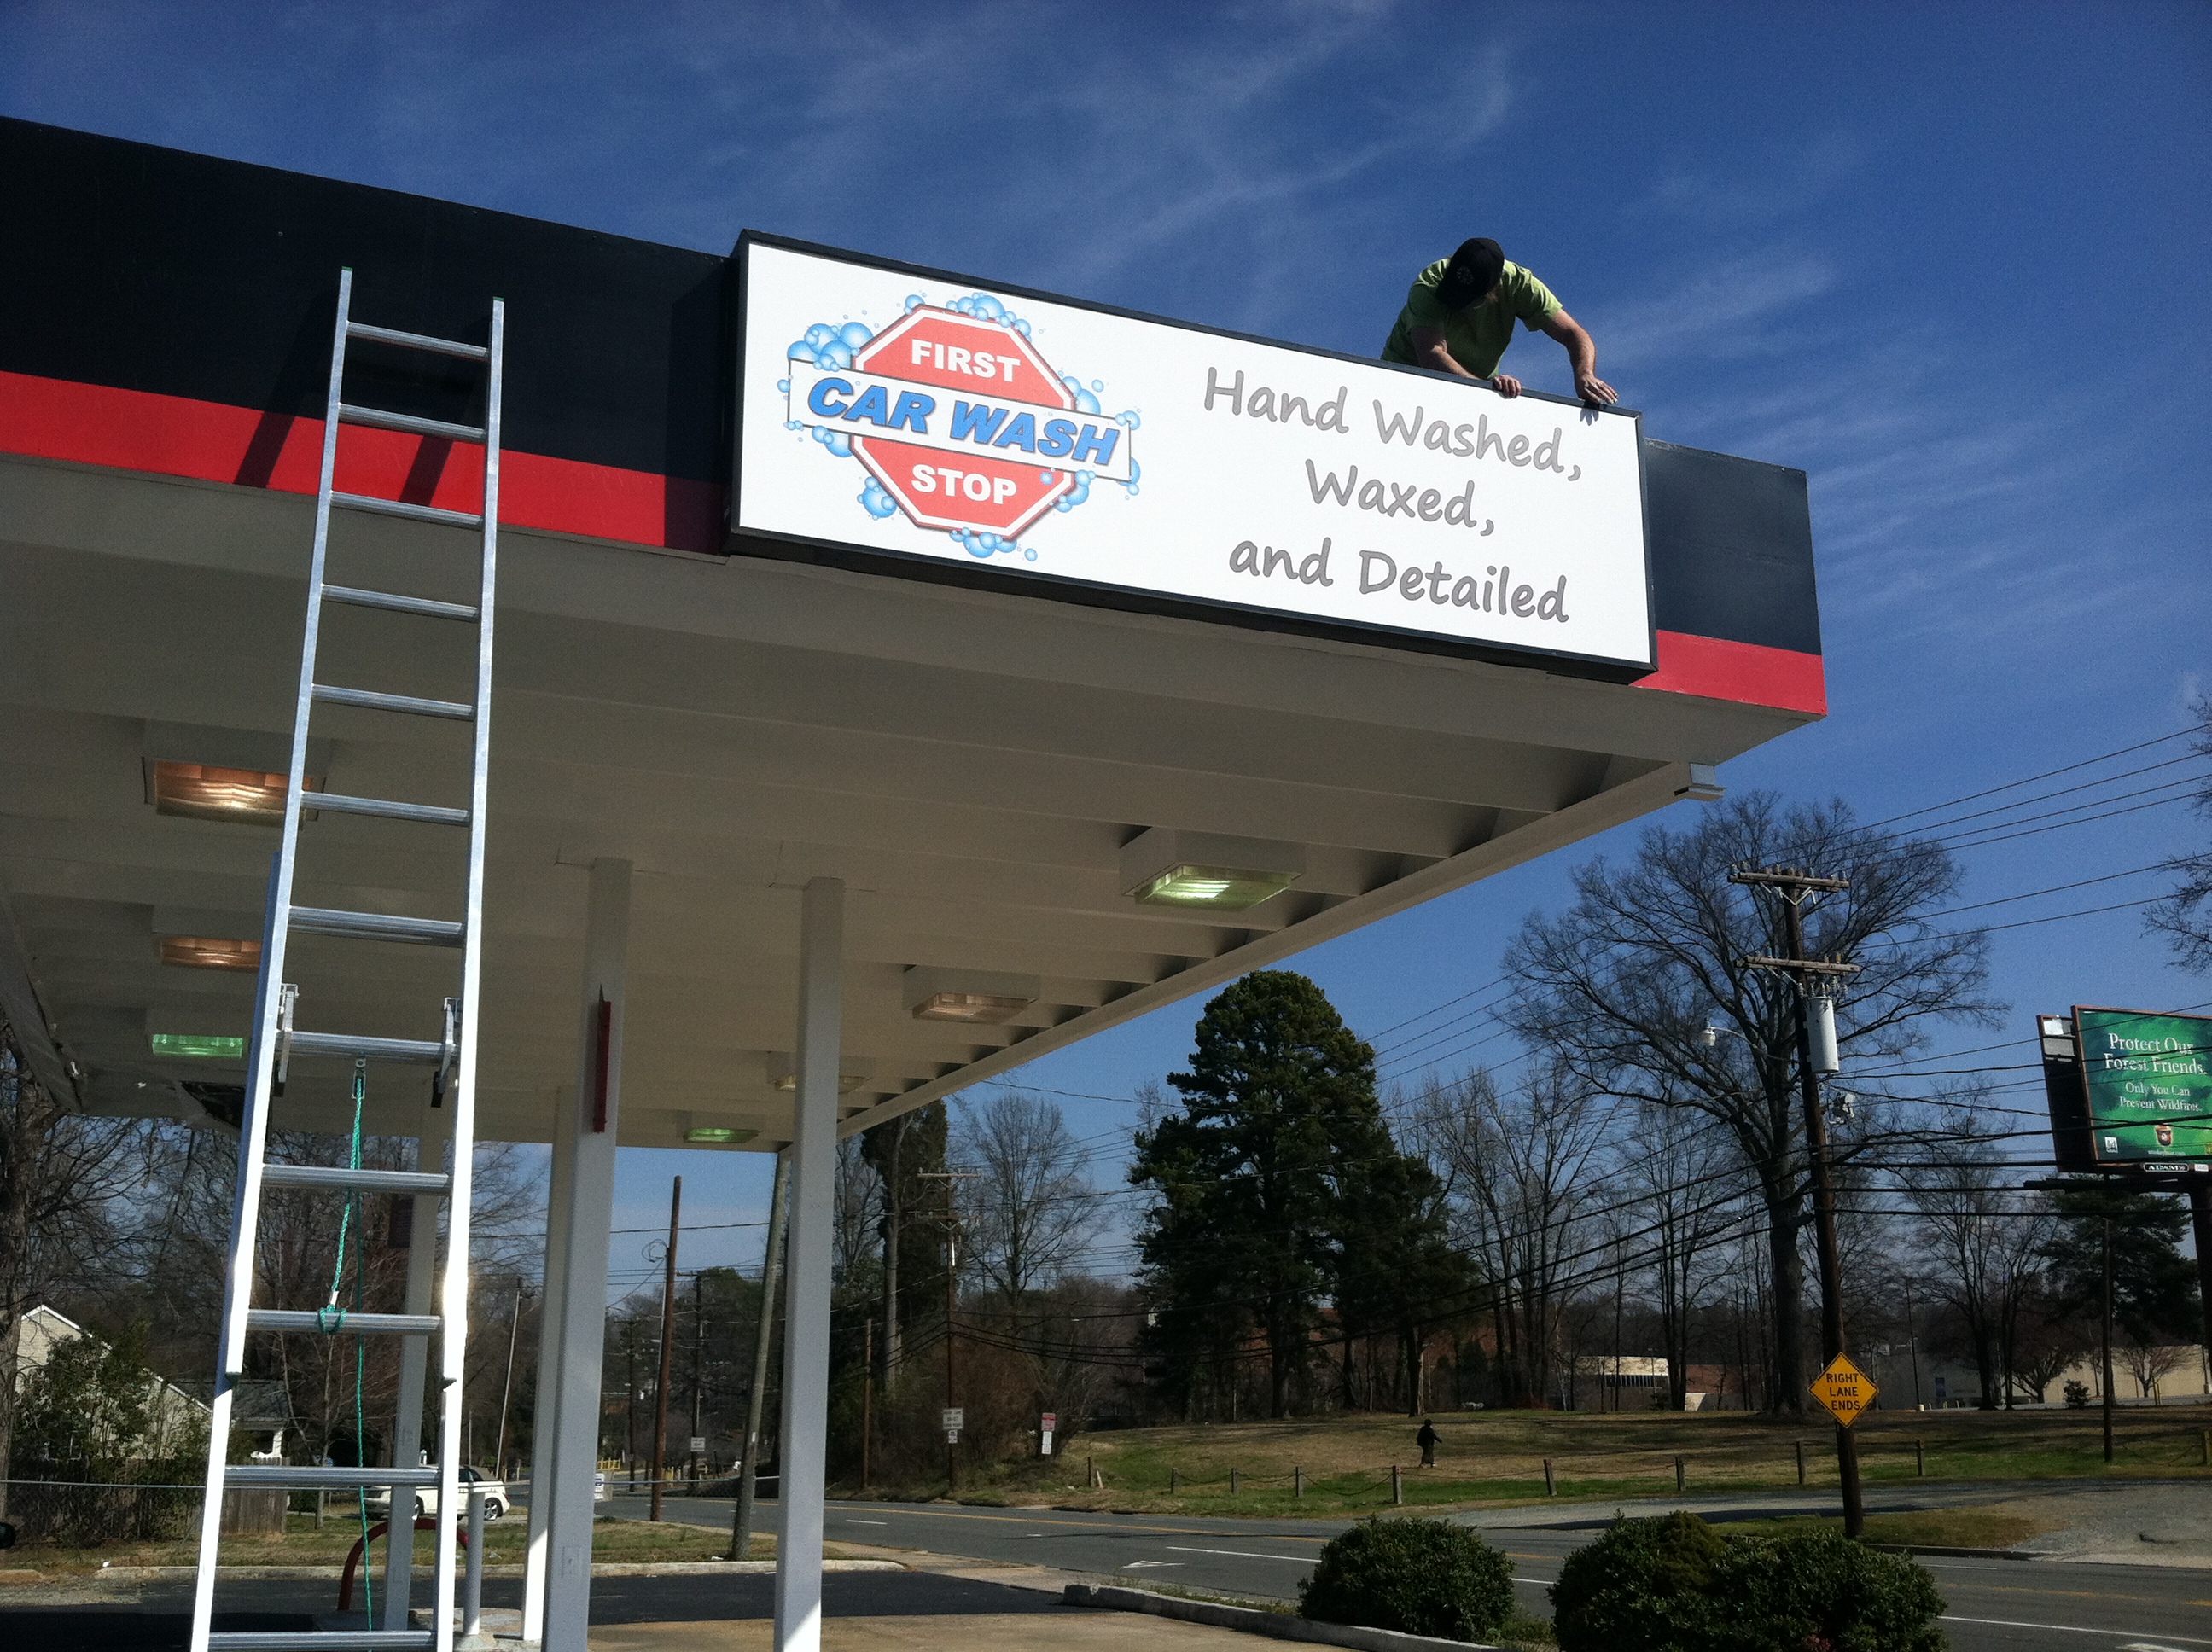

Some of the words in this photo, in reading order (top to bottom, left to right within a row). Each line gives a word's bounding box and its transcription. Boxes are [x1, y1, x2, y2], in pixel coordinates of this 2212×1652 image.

[911, 338, 1021, 382] FIRST
[807, 377, 935, 434] CAR
[950, 400, 1120, 465] WASH
[1204, 367, 1349, 433] Hand
[1373, 399, 1581, 481] Washed,
[911, 464, 1017, 504] STOP
[1305, 459, 1494, 536] Waxed,
[1229, 538, 1333, 587] and
[1359, 550, 1569, 623] Detailed
[2108, 1032, 2160, 1052] Protect
[2164, 1037, 2193, 1055] Our
[2104, 1052, 2149, 1072] Forest
[2151, 1056, 2207, 1074] Friends.
[2125, 1082, 2149, 1097] Only
[2151, 1083, 2168, 1095] You
[2171, 1085, 2191, 1096] Can
[2119, 1096, 2156, 1109] Prevent
[1826, 1373, 1859, 1383] RIGHT
[1830, 1387, 1859, 1397] LANE
[1831, 1400, 1860, 1411] ENDS
